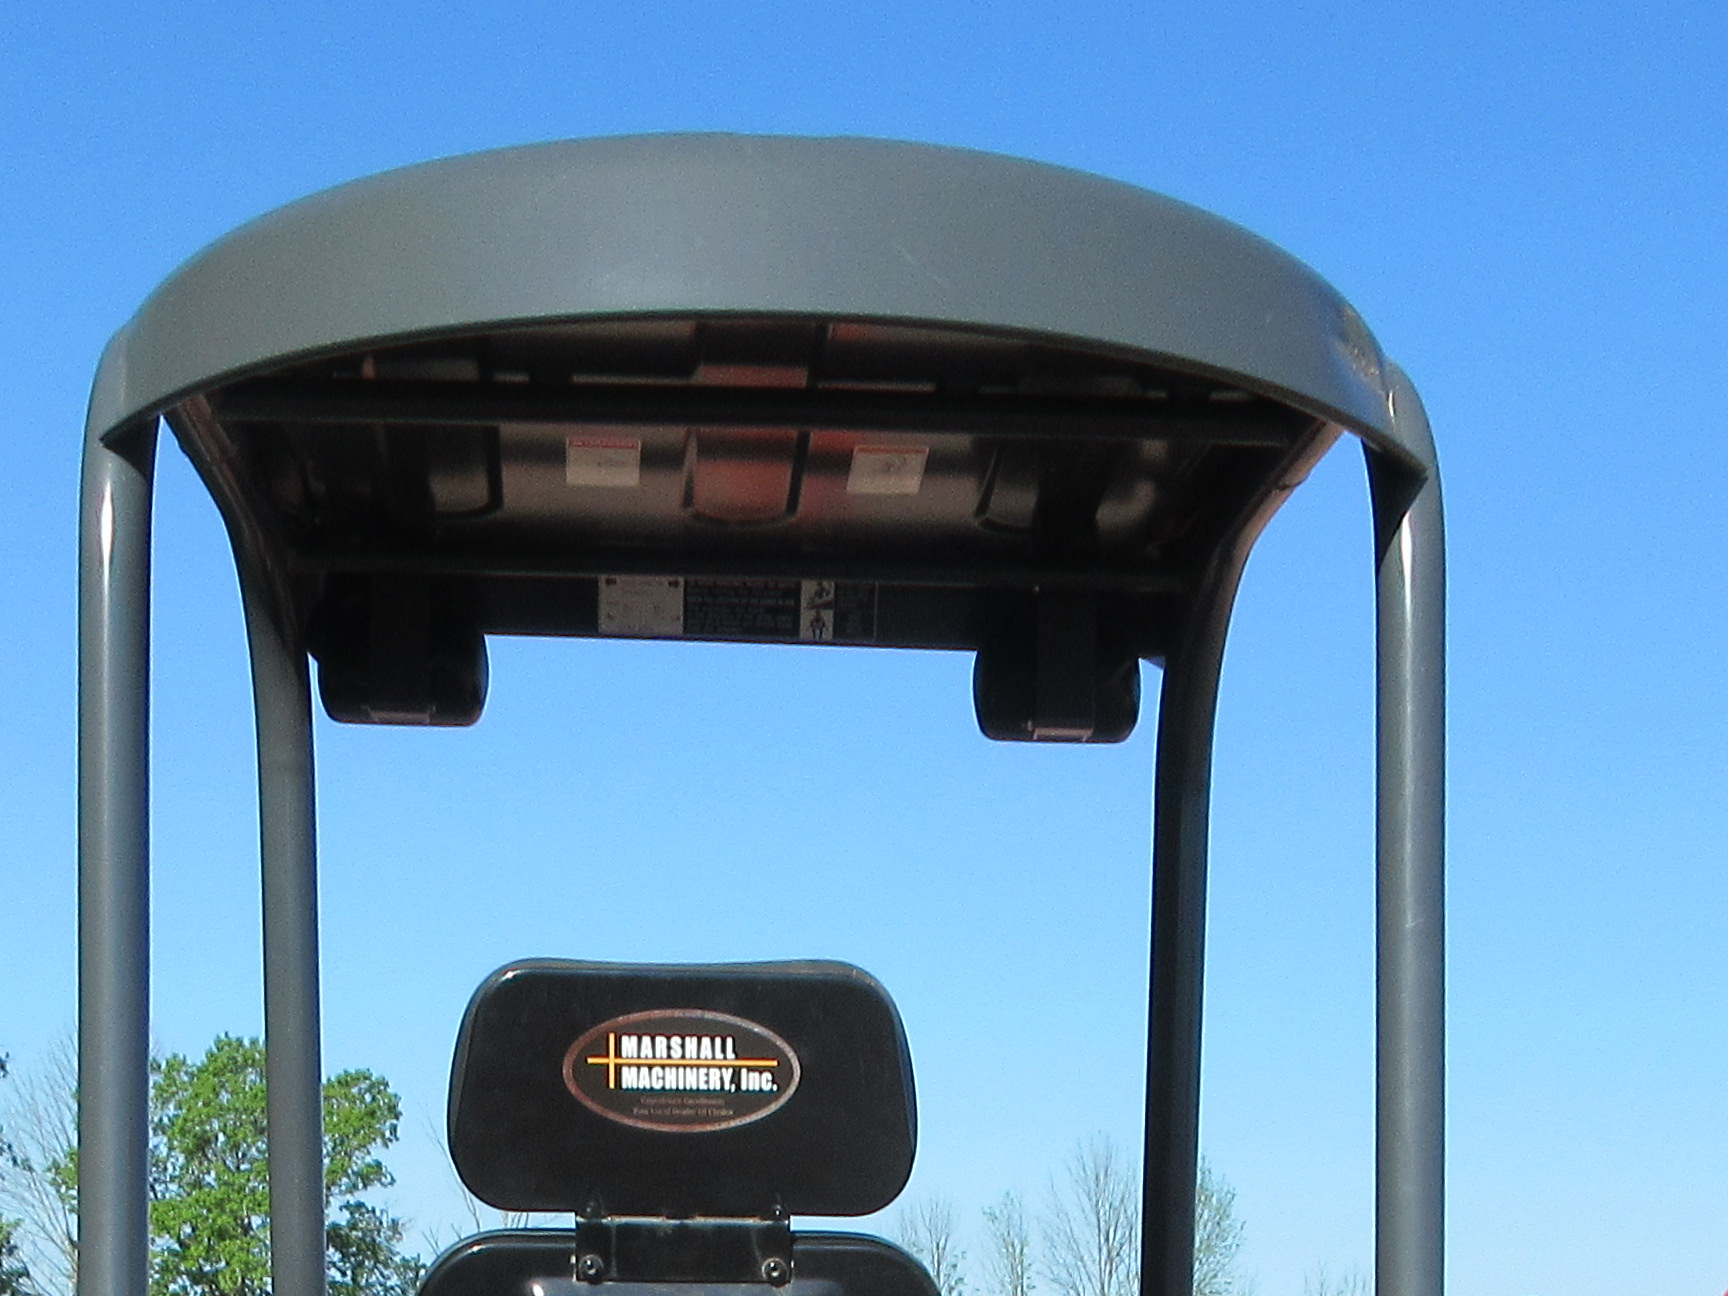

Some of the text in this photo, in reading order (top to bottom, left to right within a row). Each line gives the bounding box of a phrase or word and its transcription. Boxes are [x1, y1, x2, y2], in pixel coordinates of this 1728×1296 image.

[621, 1035, 736, 1059] MARSHALL
[621, 1066, 778, 1093] MACHINERY, Inc.
